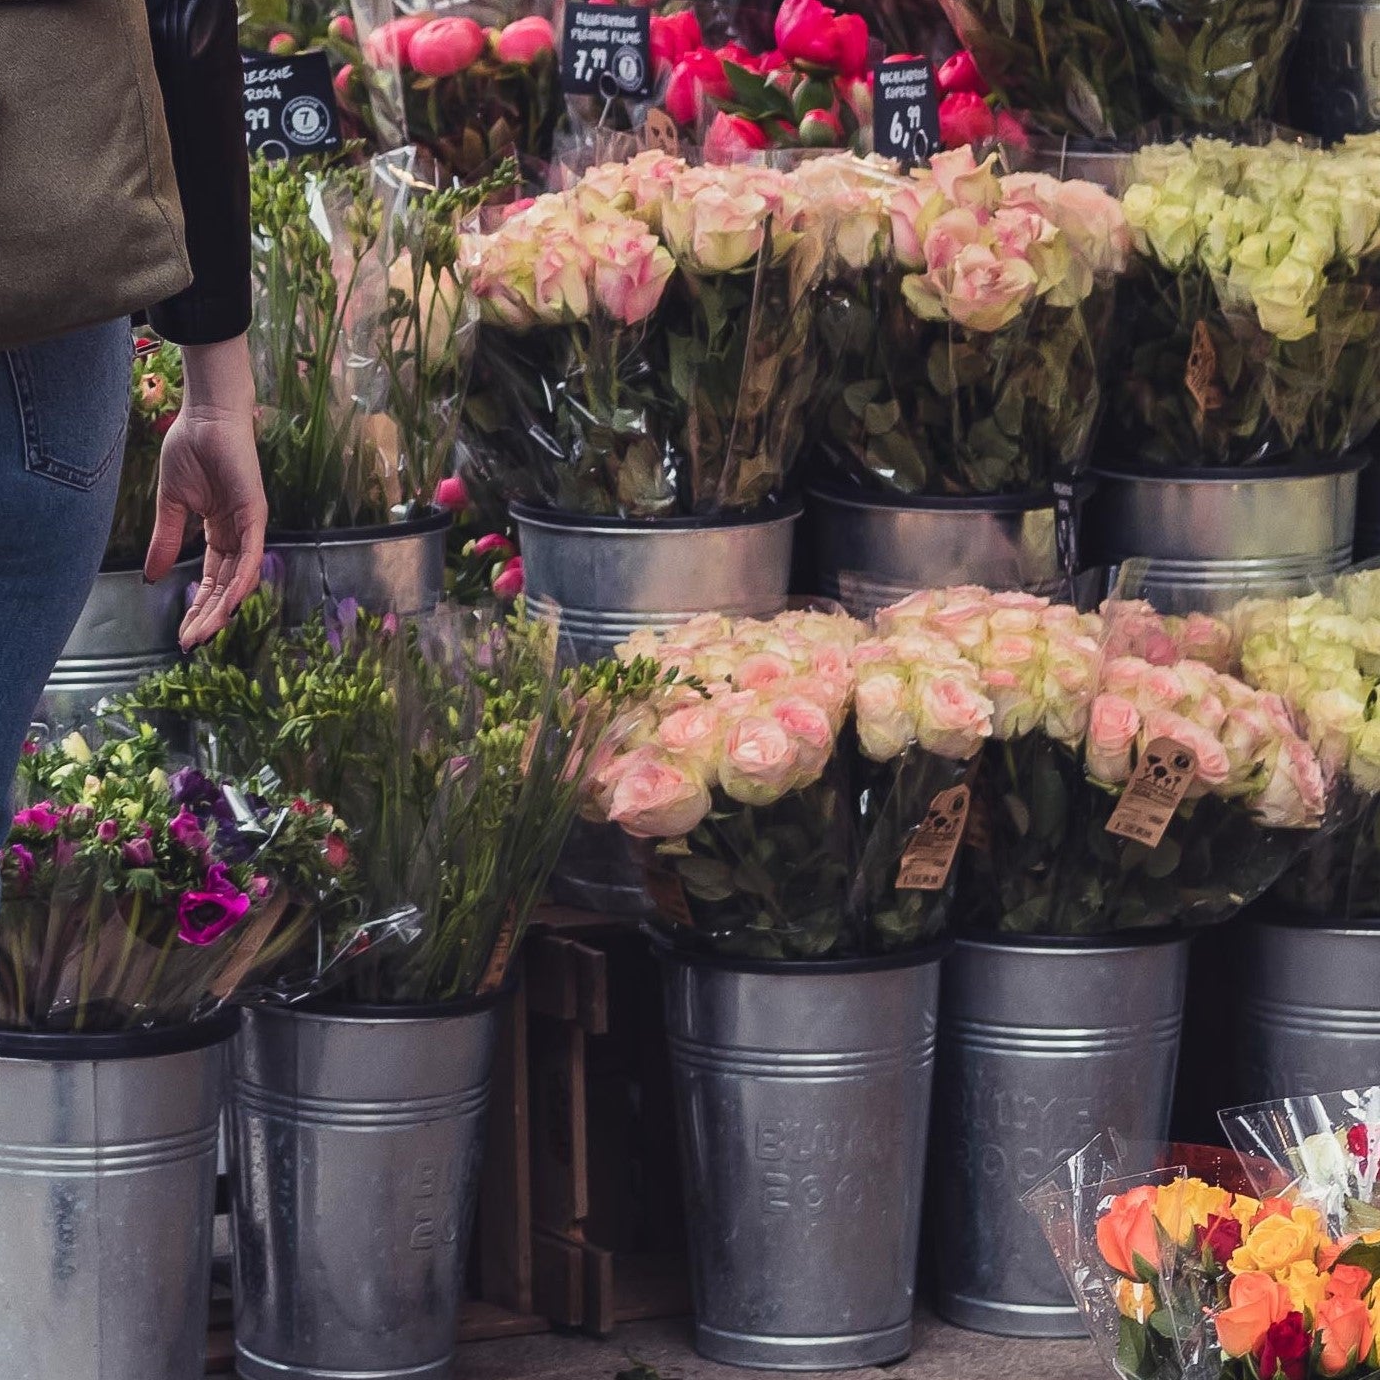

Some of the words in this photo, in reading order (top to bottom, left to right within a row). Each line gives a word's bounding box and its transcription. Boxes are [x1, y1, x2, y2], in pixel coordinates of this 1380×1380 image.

[243, 84, 281, 102] ROSA
[299, 110, 310, 126] 7
[889, 105, 921, 150] 6,99
